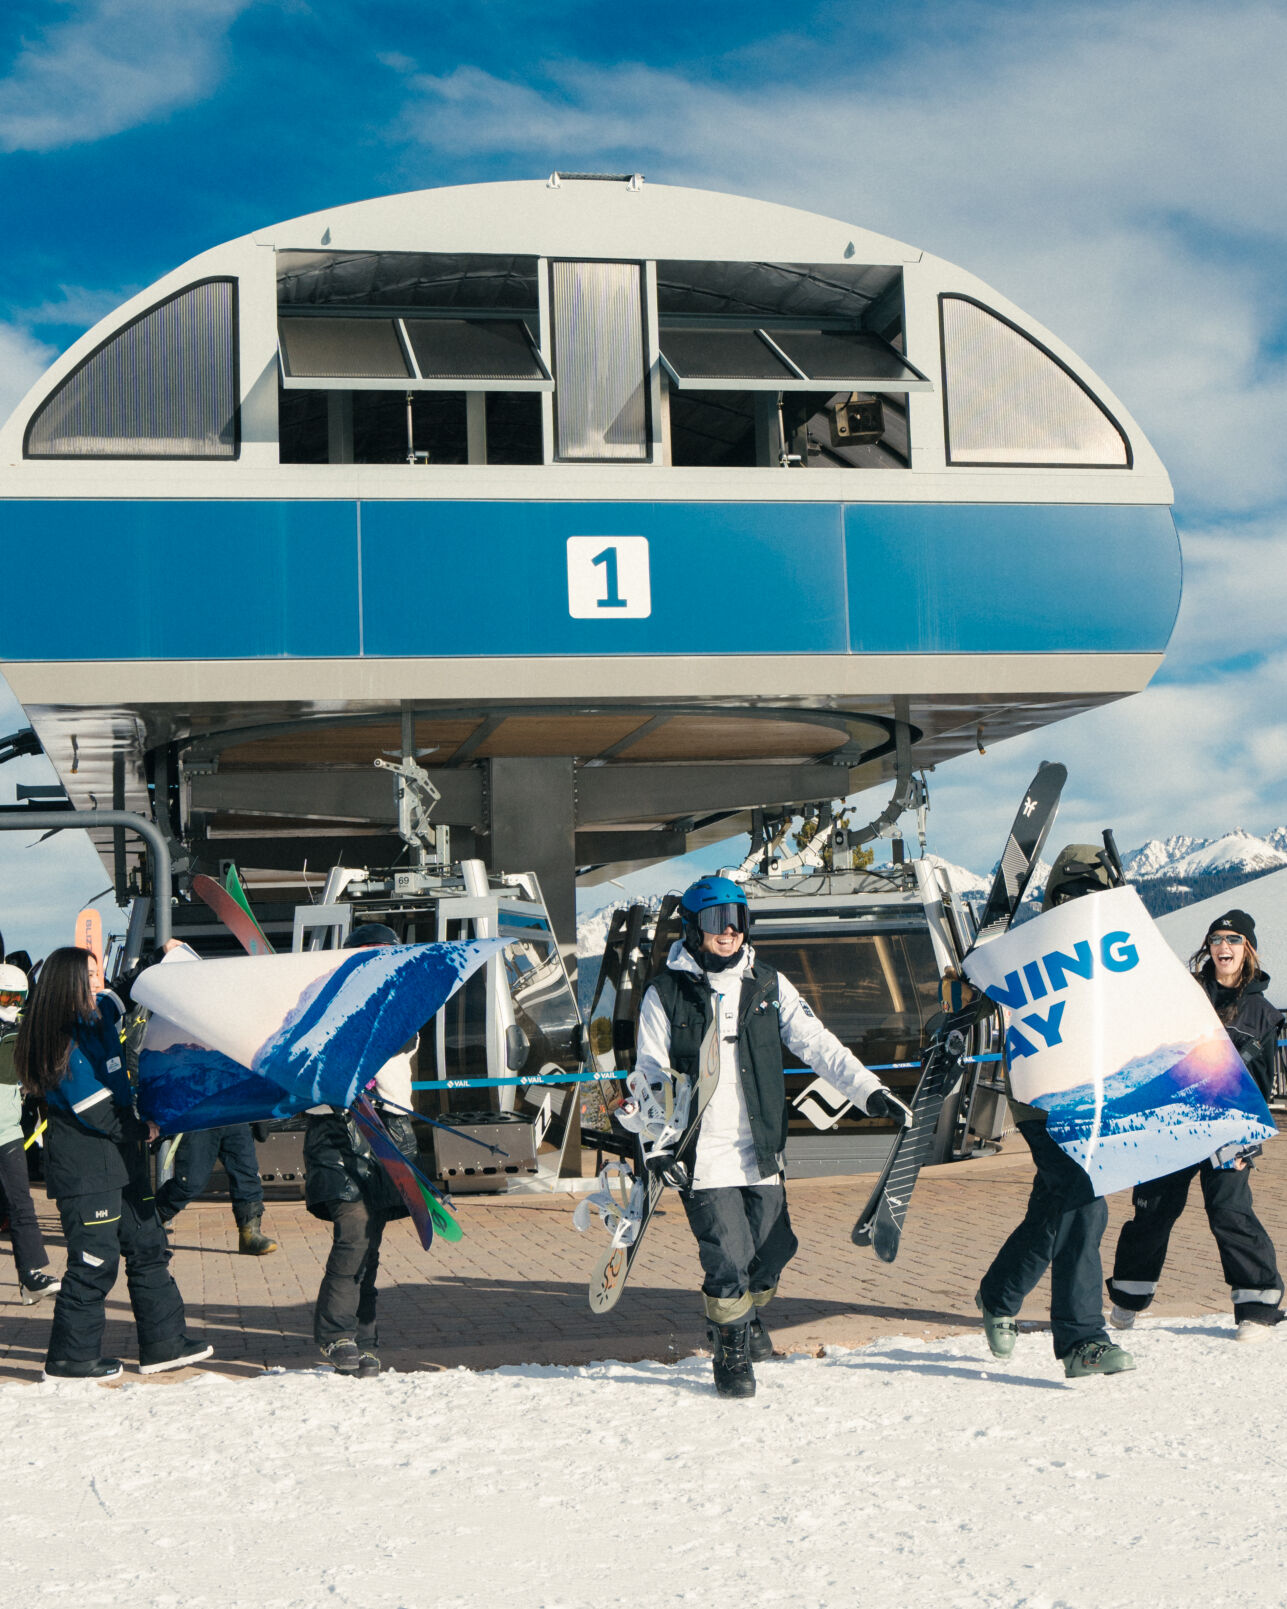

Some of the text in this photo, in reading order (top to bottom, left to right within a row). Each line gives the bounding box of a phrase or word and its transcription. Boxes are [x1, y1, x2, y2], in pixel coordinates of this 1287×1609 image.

[591, 546, 628, 608] 1
[398, 876, 410, 885] 69
[1006, 1000, 1066, 1073] AY
[95, 1209, 108, 1219] HH
